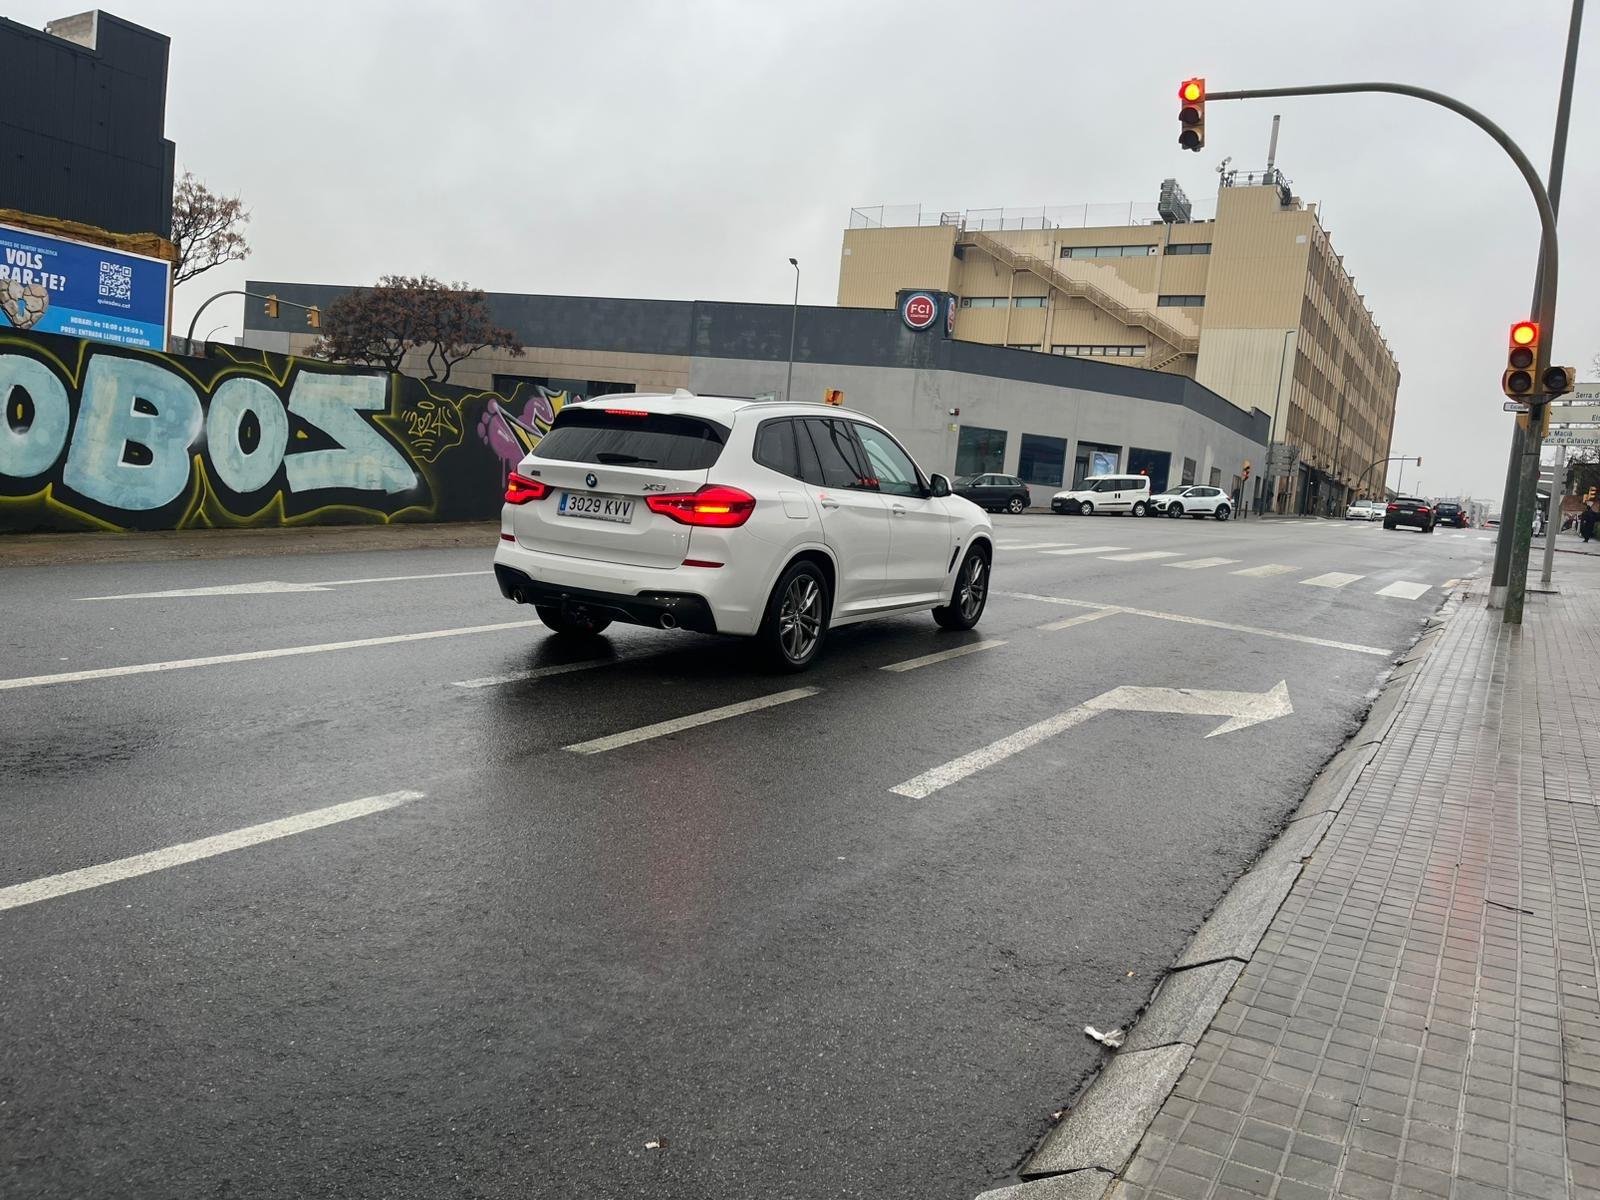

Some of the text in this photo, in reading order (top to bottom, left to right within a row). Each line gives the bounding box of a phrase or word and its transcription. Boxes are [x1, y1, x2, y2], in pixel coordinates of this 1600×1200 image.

[6, 247, 43, 270] VOLS
[910, 304, 930, 314] FCI
[1575, 391, 1592, 399] Serra
[569, 496, 631, 516] 3029 KVV
